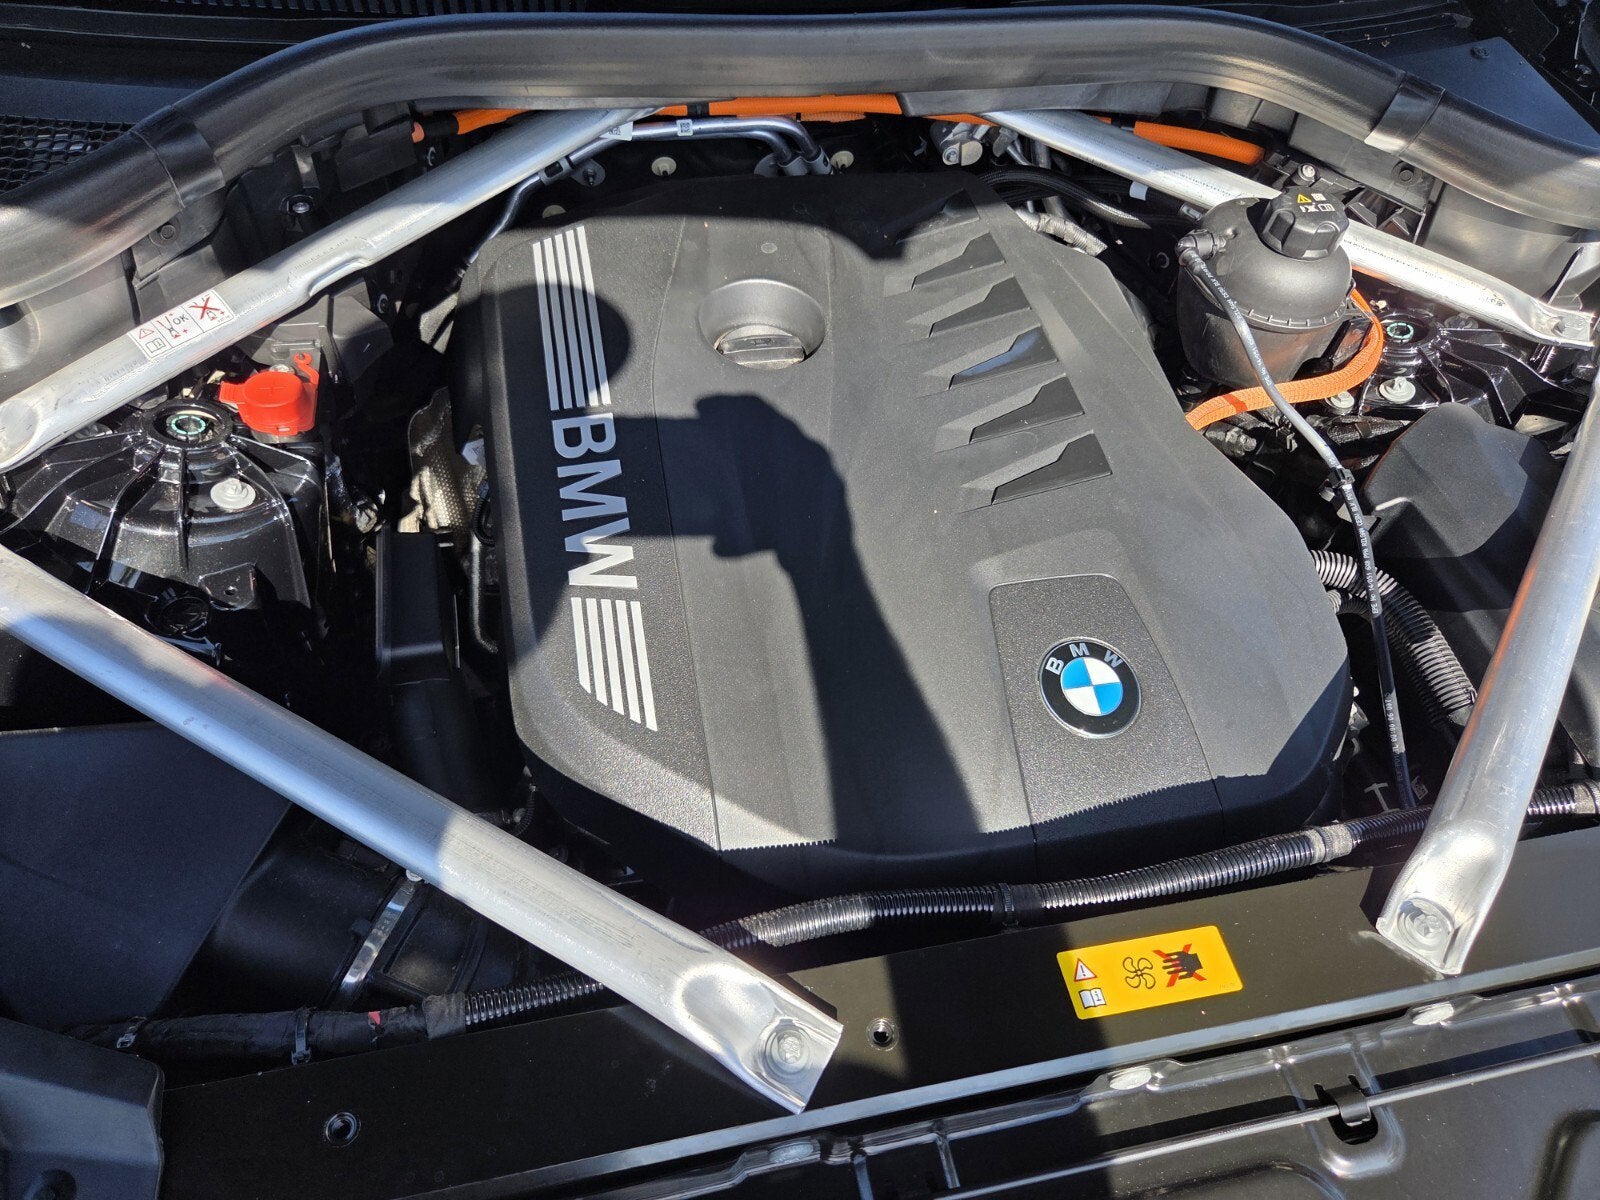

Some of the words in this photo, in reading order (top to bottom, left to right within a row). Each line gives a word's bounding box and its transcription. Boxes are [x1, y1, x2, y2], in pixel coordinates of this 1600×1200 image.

[173, 314, 189, 325] OK
[552, 413, 638, 589] BMW
[1045, 642, 1124, 676] BMW
